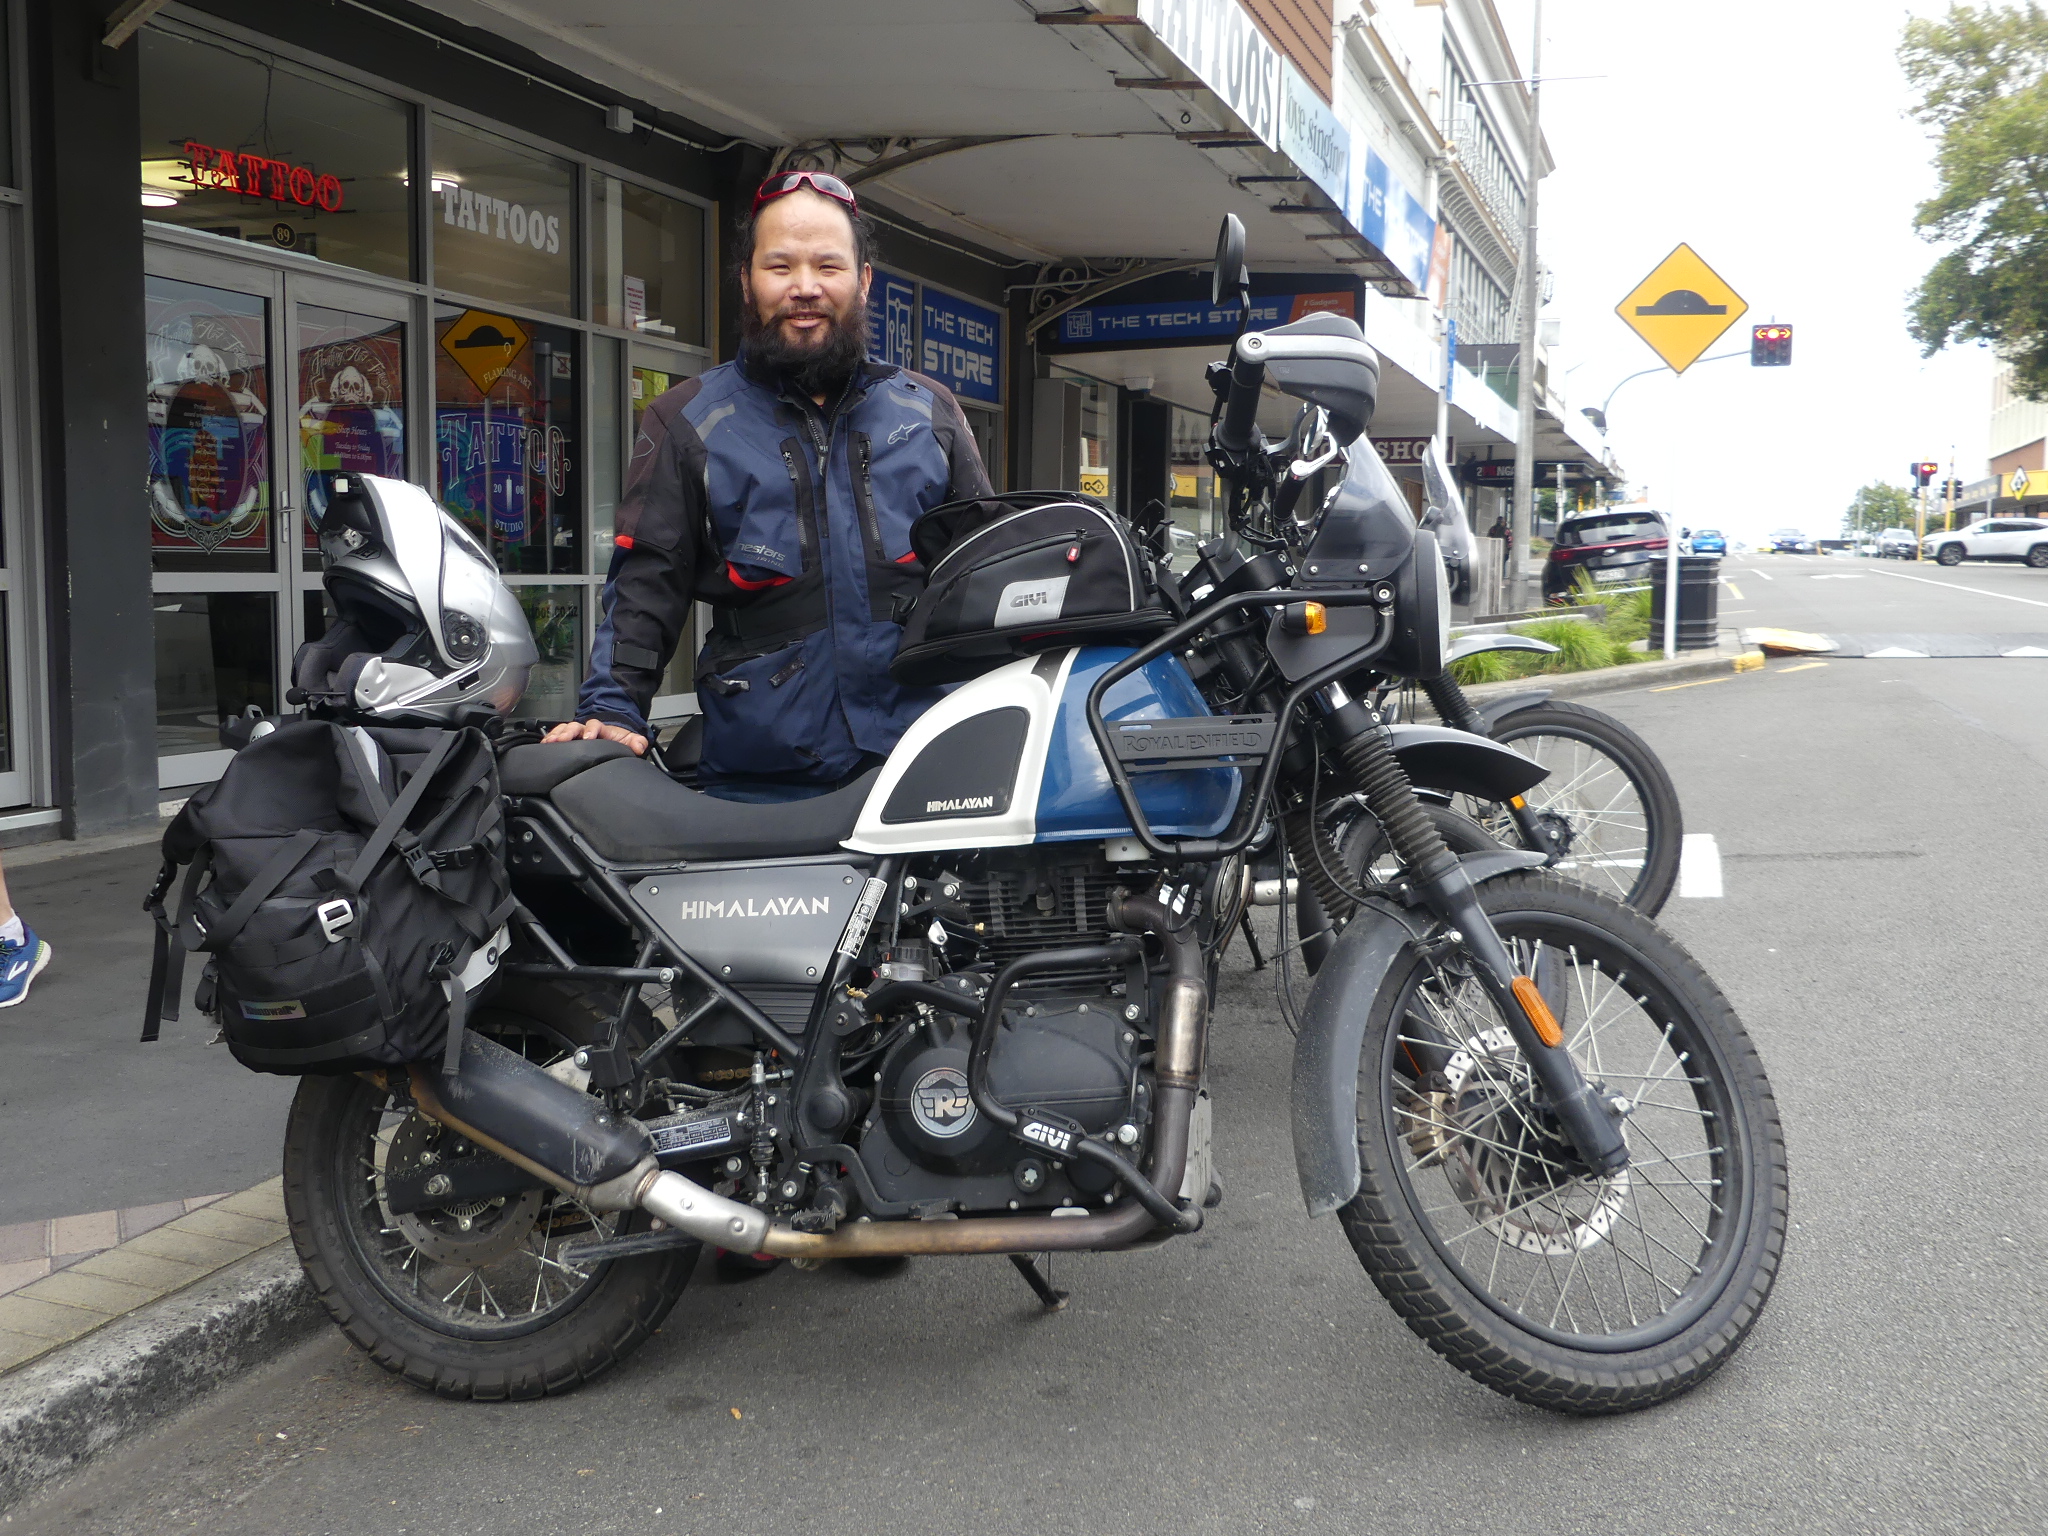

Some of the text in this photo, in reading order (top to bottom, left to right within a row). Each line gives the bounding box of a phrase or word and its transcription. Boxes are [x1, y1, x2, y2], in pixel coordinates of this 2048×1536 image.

[1284, 76, 1306, 141] love
[184, 141, 344, 212] TATTOO
[440, 182, 560, 255] TATTOOS
[276, 228, 291, 242] 89
[923, 305, 993, 347] THE TECH
[1098, 314, 1140, 330] THE
[1146, 312, 1201, 328] TECH
[924, 339, 993, 386] STORE
[483, 366, 533, 391] FLAMING ART
[955, 381, 962, 393] 91
[336, 423, 351, 438] Shop
[439, 413, 572, 497] TATTOO
[1375, 441, 1430, 460] SHO
[493, 483, 525, 495] 20 08
[494, 518, 524, 533] STUDIO
[1009, 591, 1048, 609] GIVI
[1122, 731, 1263, 752] ROYAL ENFIELD
[927, 796, 994, 813] HIMALAYAN
[681, 897, 830, 920] HIMALAYAN
[1022, 1121, 1071, 1151] GIVI
